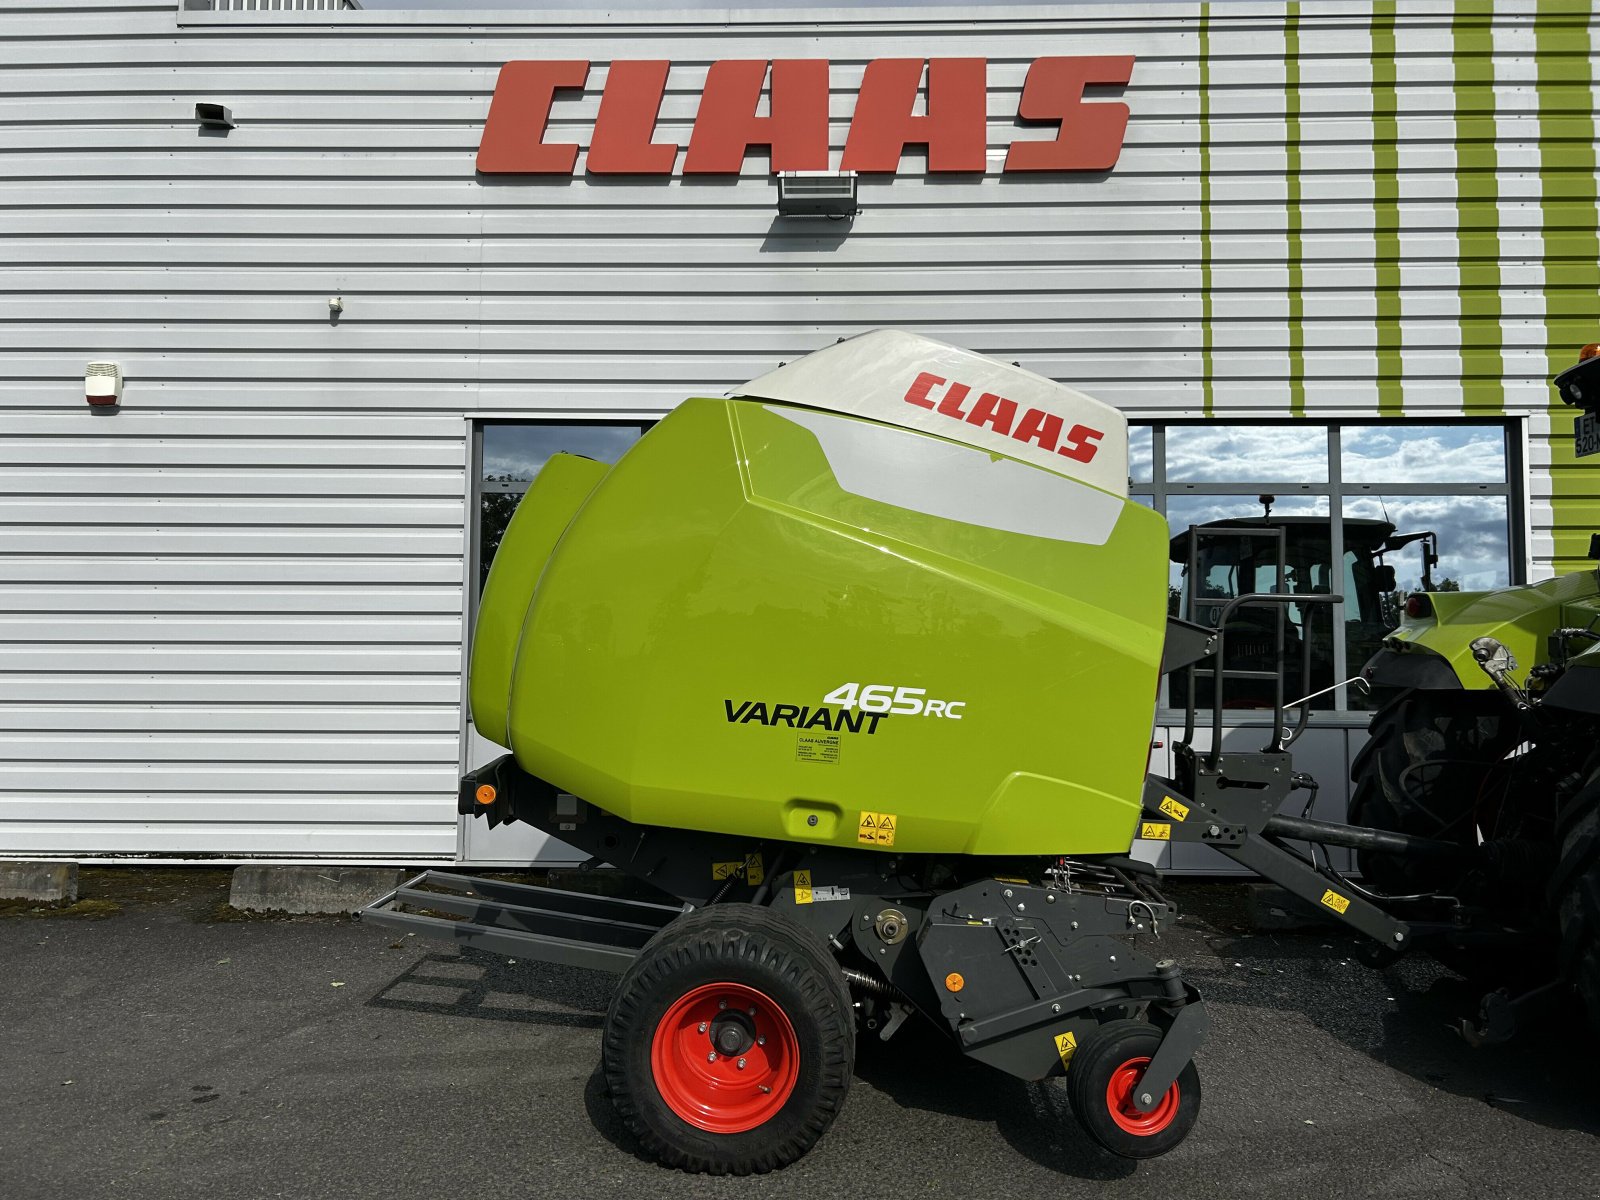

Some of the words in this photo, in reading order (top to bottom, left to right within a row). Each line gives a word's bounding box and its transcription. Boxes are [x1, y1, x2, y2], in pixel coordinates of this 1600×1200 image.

[476, 55, 1135, 174] CLAAS
[903, 371, 1105, 464] CLAAS
[724, 699, 889, 735] VARIANT
